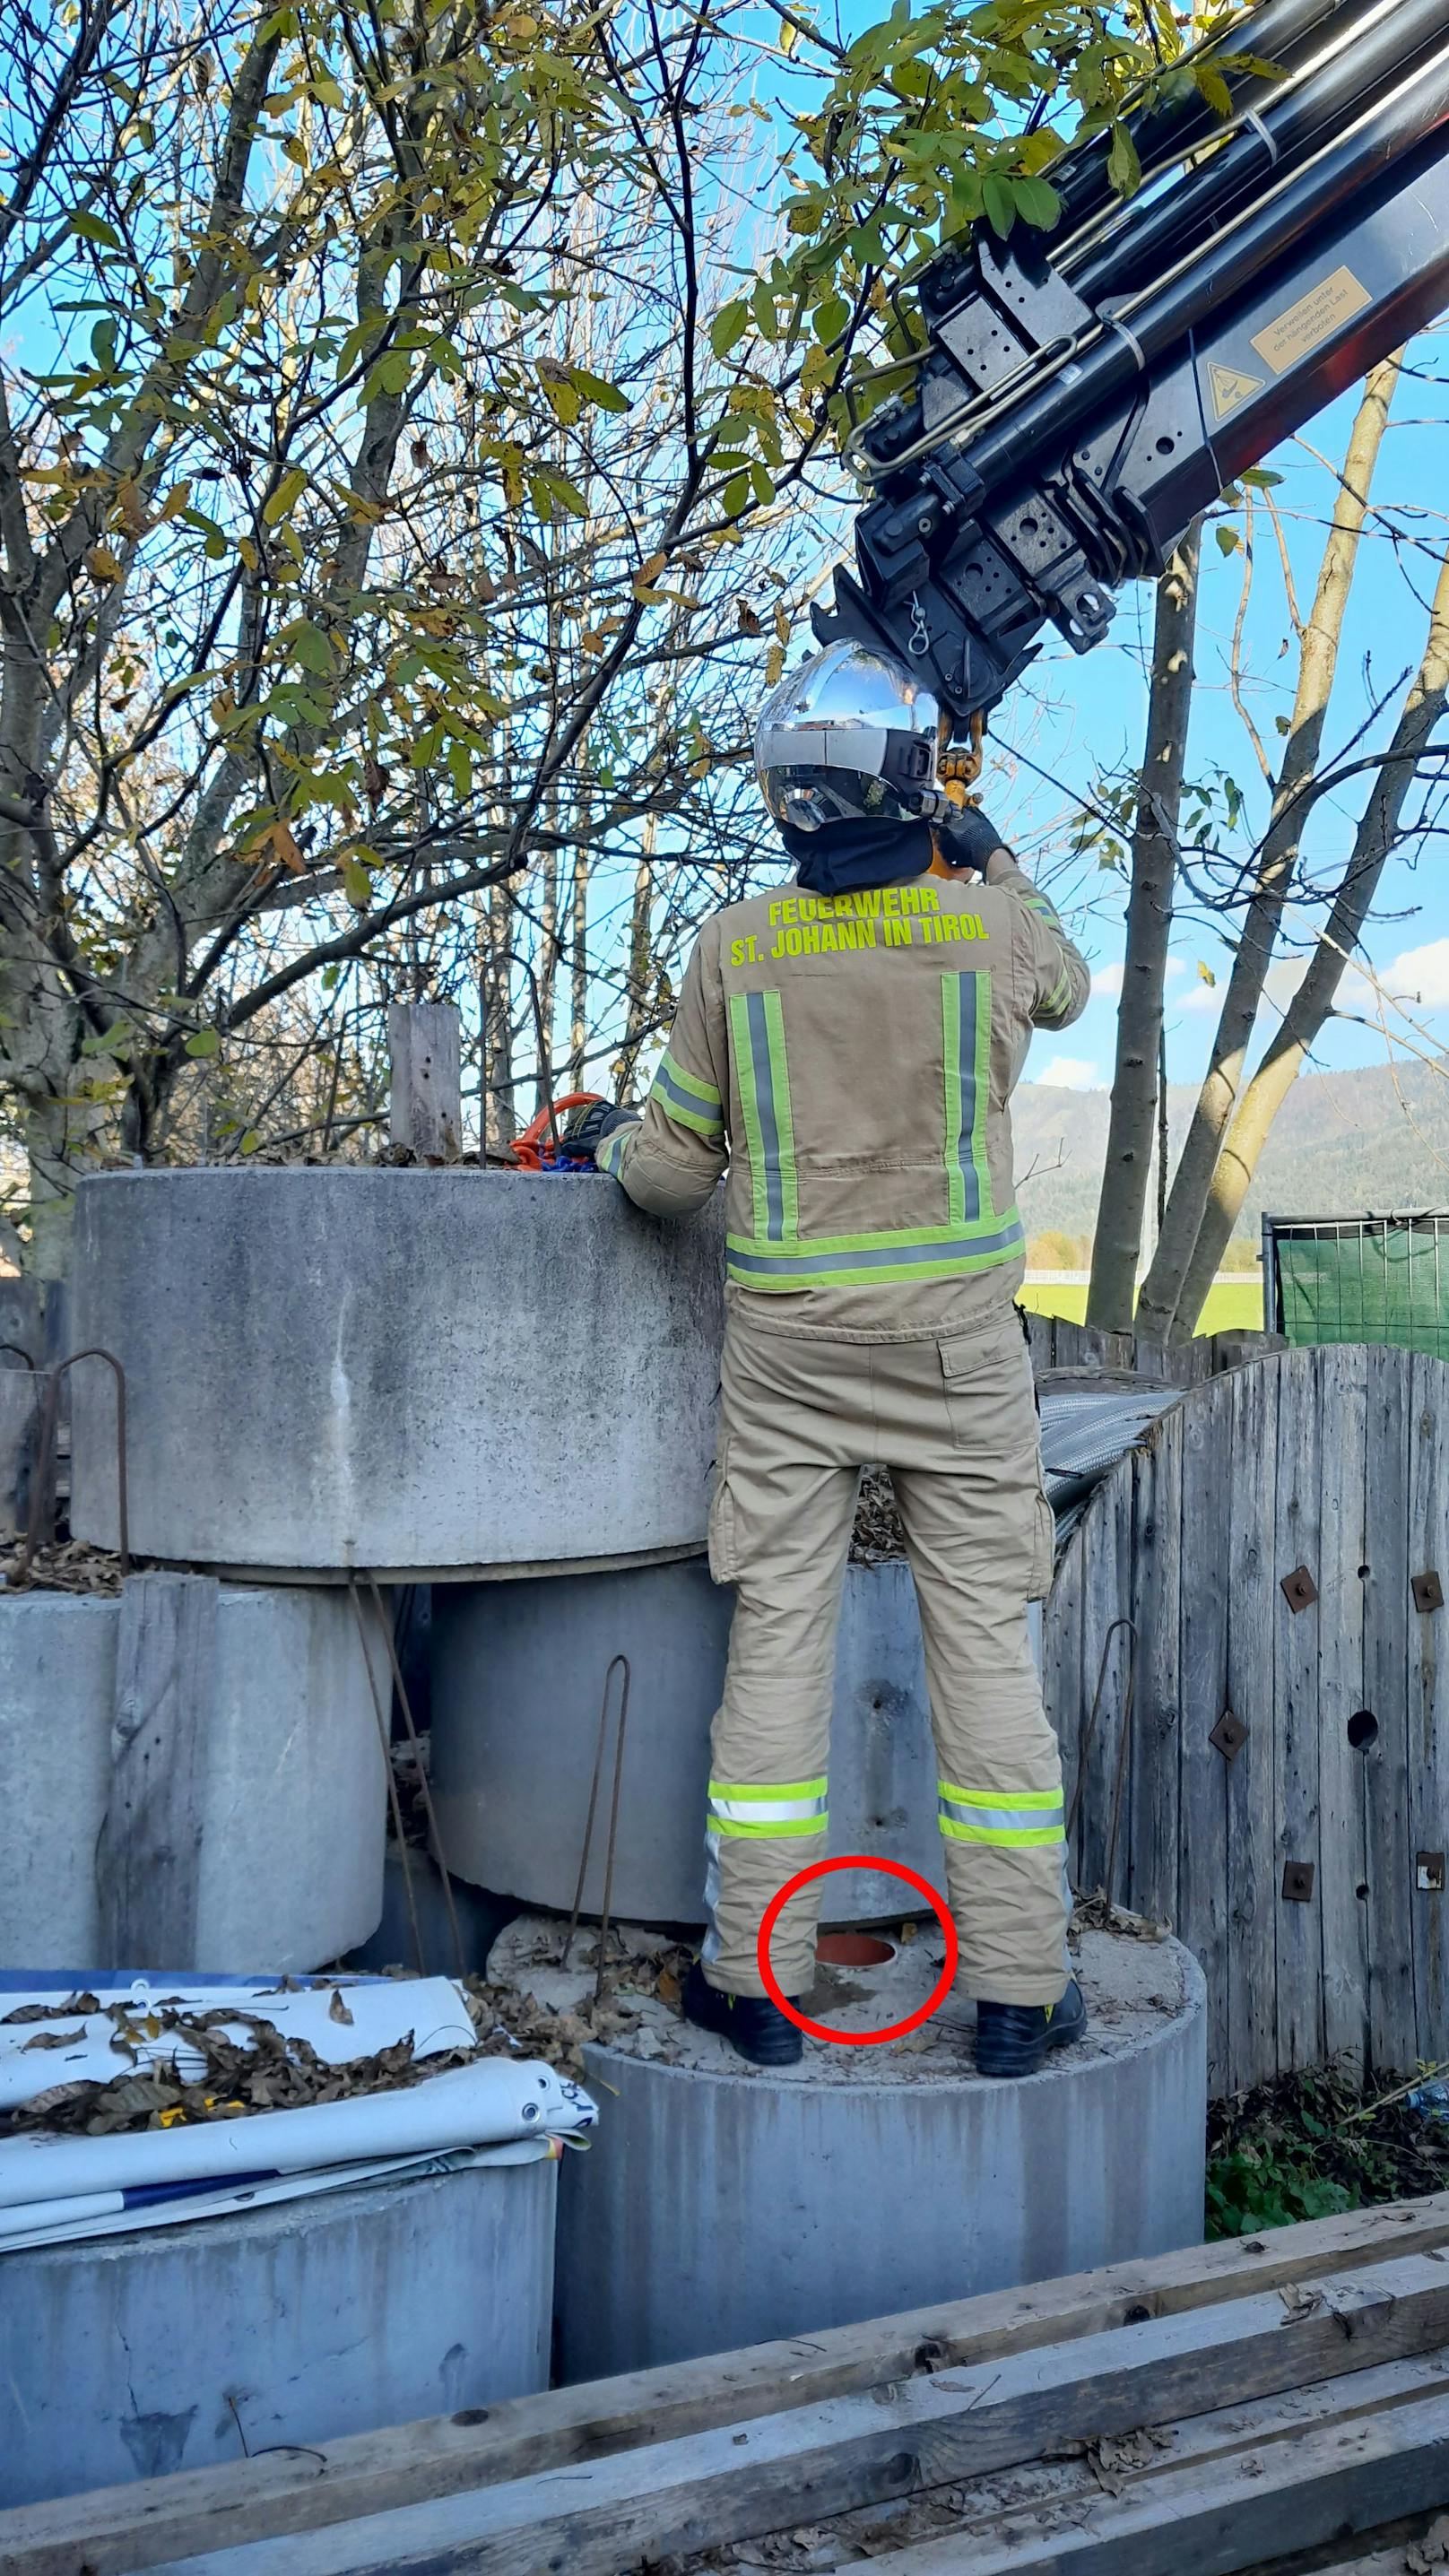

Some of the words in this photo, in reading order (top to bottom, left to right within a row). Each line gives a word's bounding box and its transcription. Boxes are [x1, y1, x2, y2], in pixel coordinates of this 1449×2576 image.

[1313, 287, 1333, 306] unter
[1330, 289, 1349, 306] Last
[768, 887, 940, 926] FEUERWEHR
[731, 934, 765, 967] ST.
[771, 918, 875, 958] JOHANN
[882, 917, 912, 947] IN
[918, 913, 990, 943] TIROL
